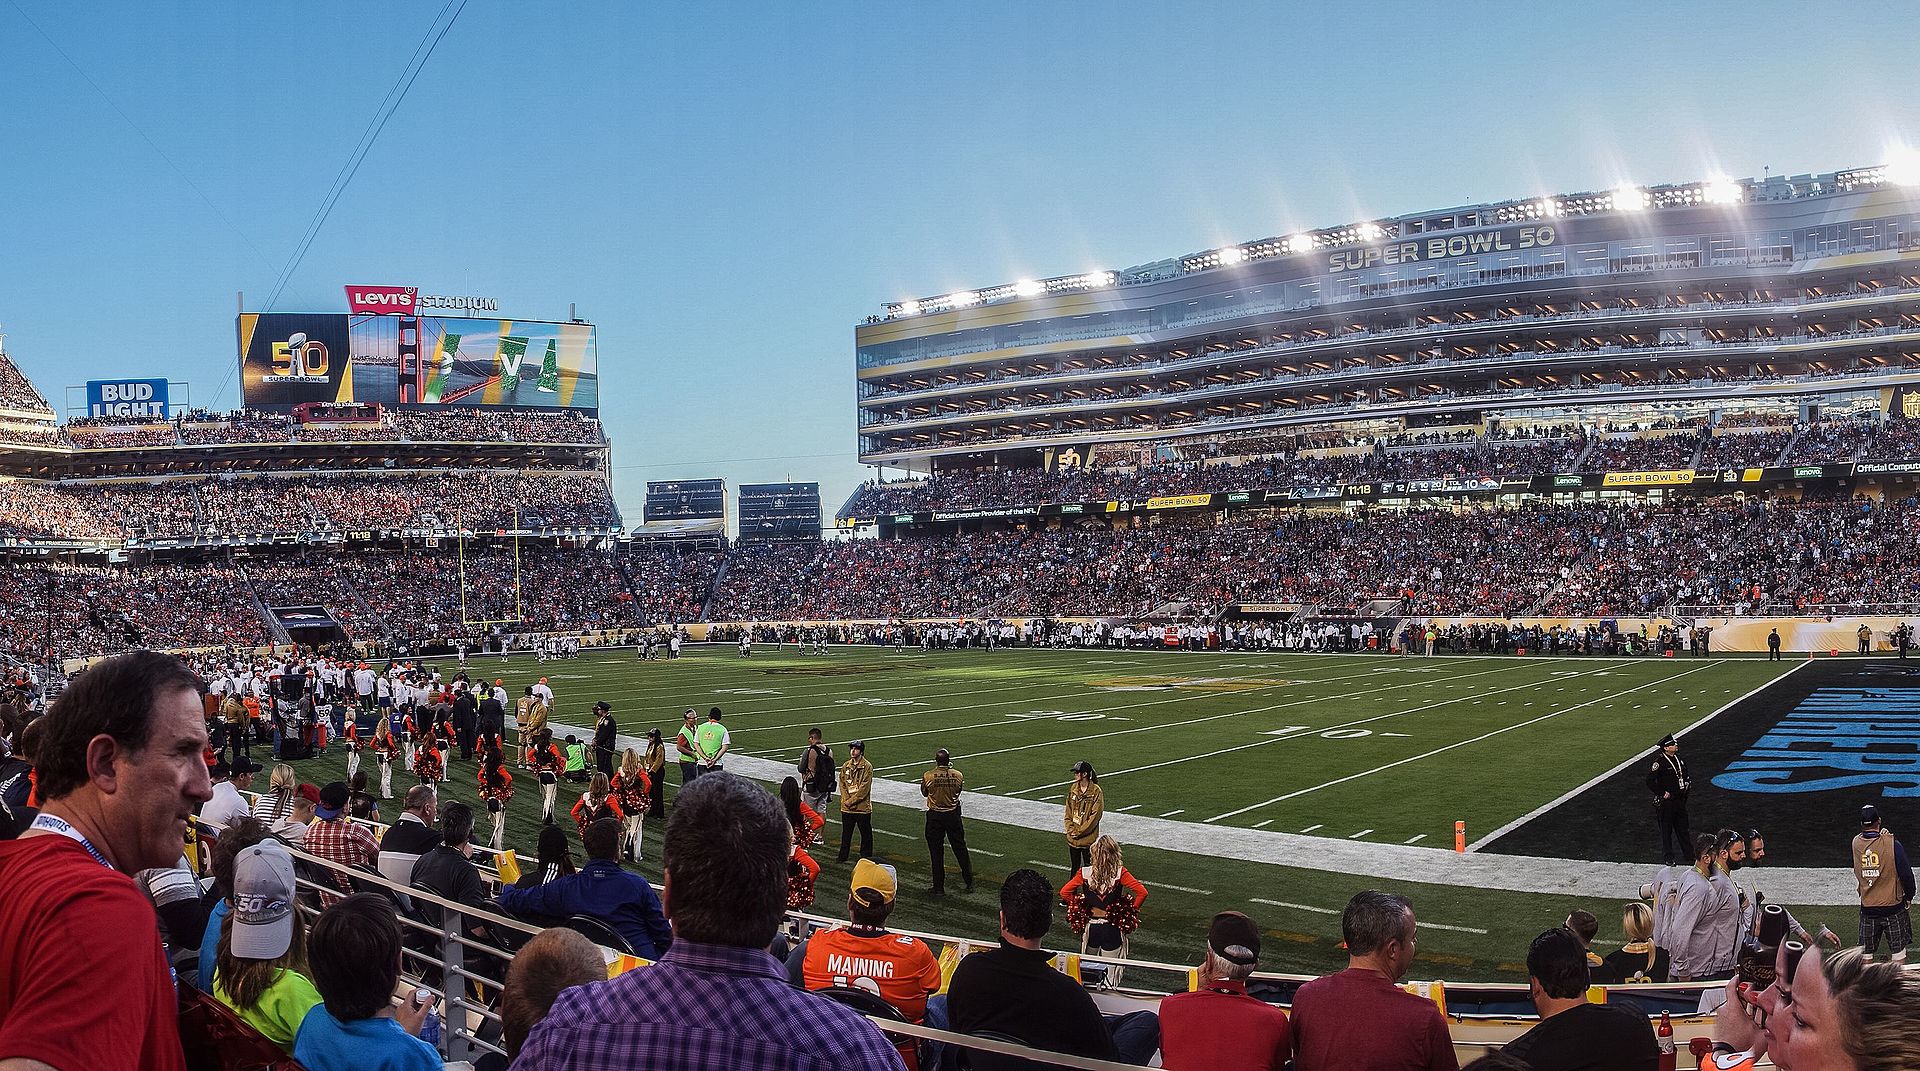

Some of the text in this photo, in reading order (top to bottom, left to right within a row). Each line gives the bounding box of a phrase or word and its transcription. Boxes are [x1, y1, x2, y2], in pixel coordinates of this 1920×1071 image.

[1329, 226, 1555, 273] SUPER BOWL 50
[422, 295, 499, 311] STADIUM
[271, 340, 329, 376] 50
[101, 383, 154, 402] BUD
[92, 401, 164, 419] LIGHT
[1857, 464, 1888, 472] Official
[1795, 469, 1822, 477] Lenovo
[1608, 475, 1642, 483] SUPER
[1645, 474, 1672, 482] BOWL
[1396, 484, 1404, 492] 12
[1465, 480, 1478, 489] 10
[1313, 488, 1321, 497] 7
[1348, 485, 1371, 494] 11:18
[1150, 499, 1174, 507] SUPER
[1175, 497, 1196, 505] BOWL
[981, 509, 1005, 517] Provider
[349, 531, 371, 539] 11:18
[319, 709, 330, 718] 59
[1256, 725, 1373, 739] 10
[237, 897, 263, 913] 50
